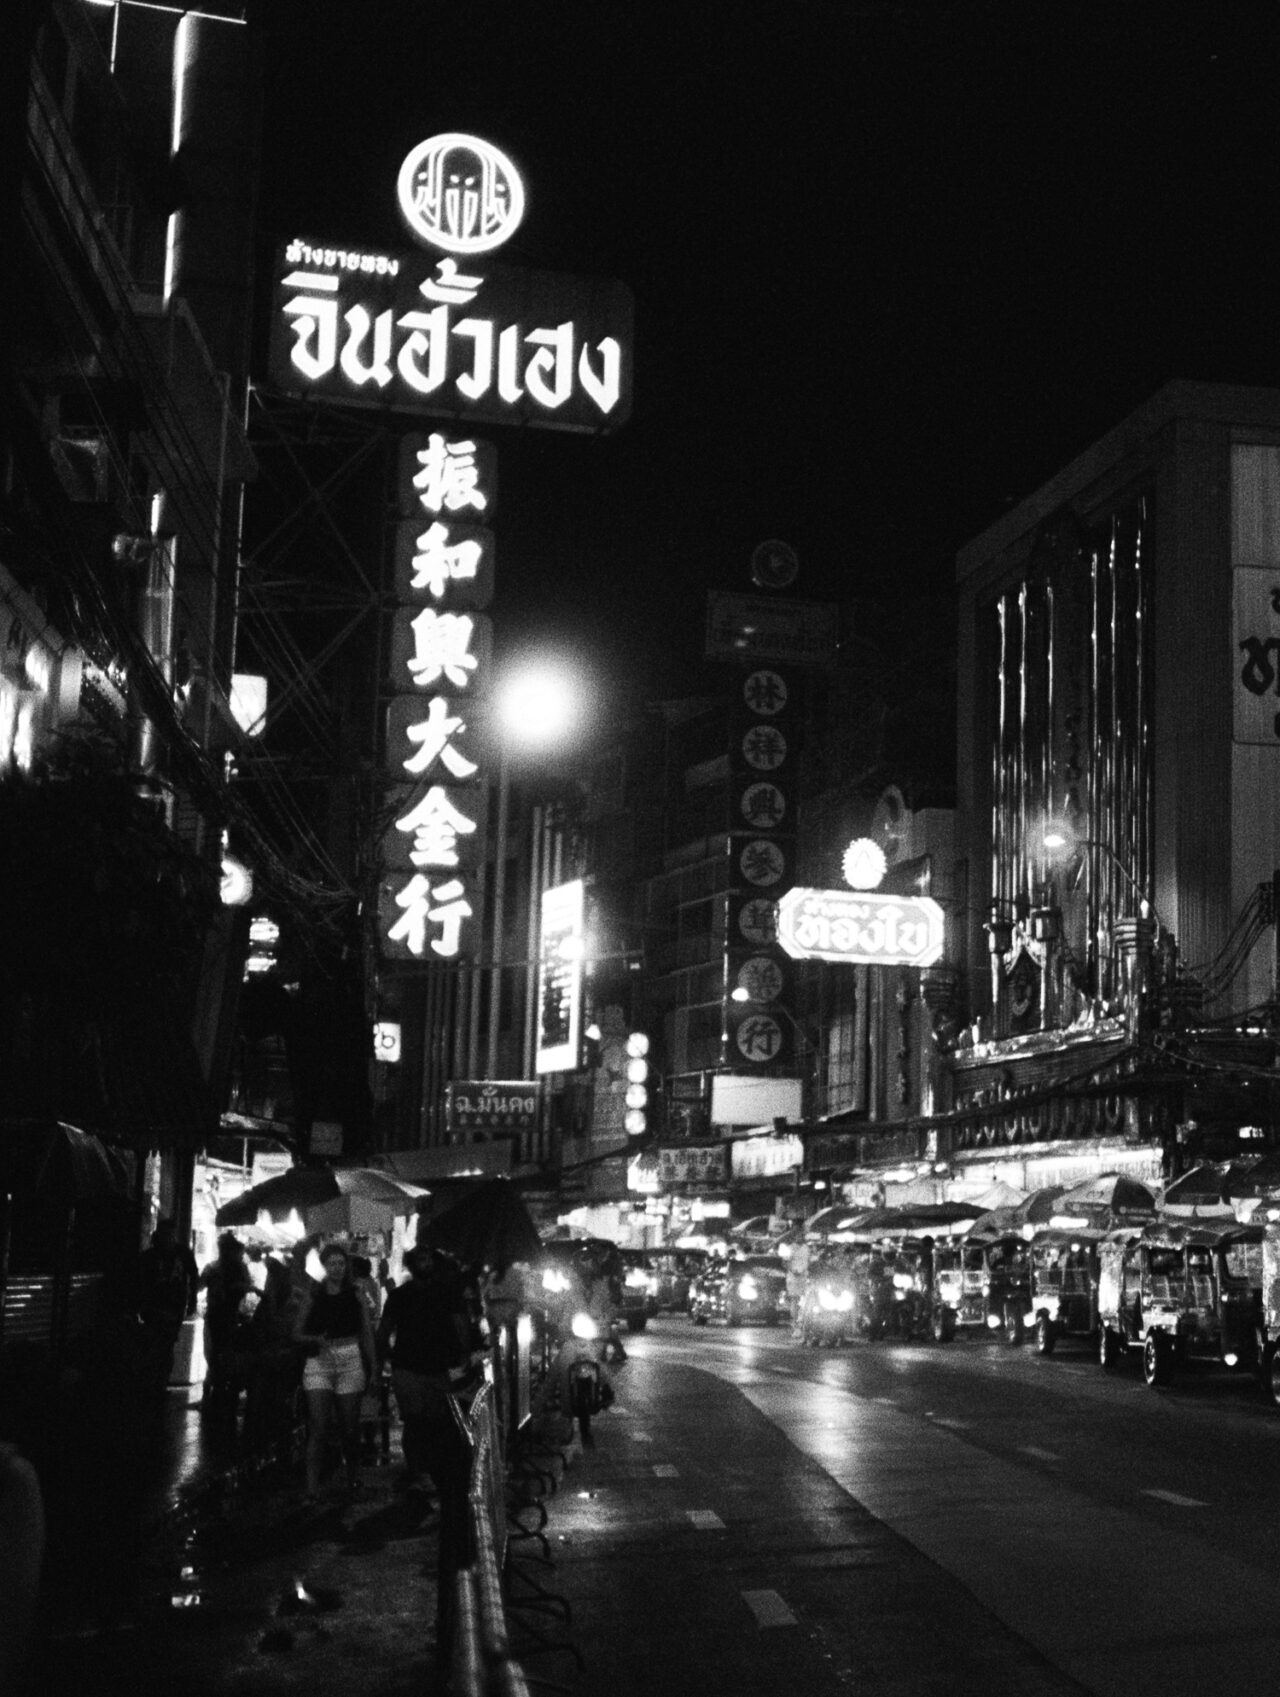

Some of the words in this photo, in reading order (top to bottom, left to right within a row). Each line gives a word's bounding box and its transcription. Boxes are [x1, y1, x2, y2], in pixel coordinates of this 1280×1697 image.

[281, 256, 622, 415] จินฮั้วเฮง
[388, 433, 488, 957] 振和興大金行
[795, 905, 929, 955] ทองใบ
